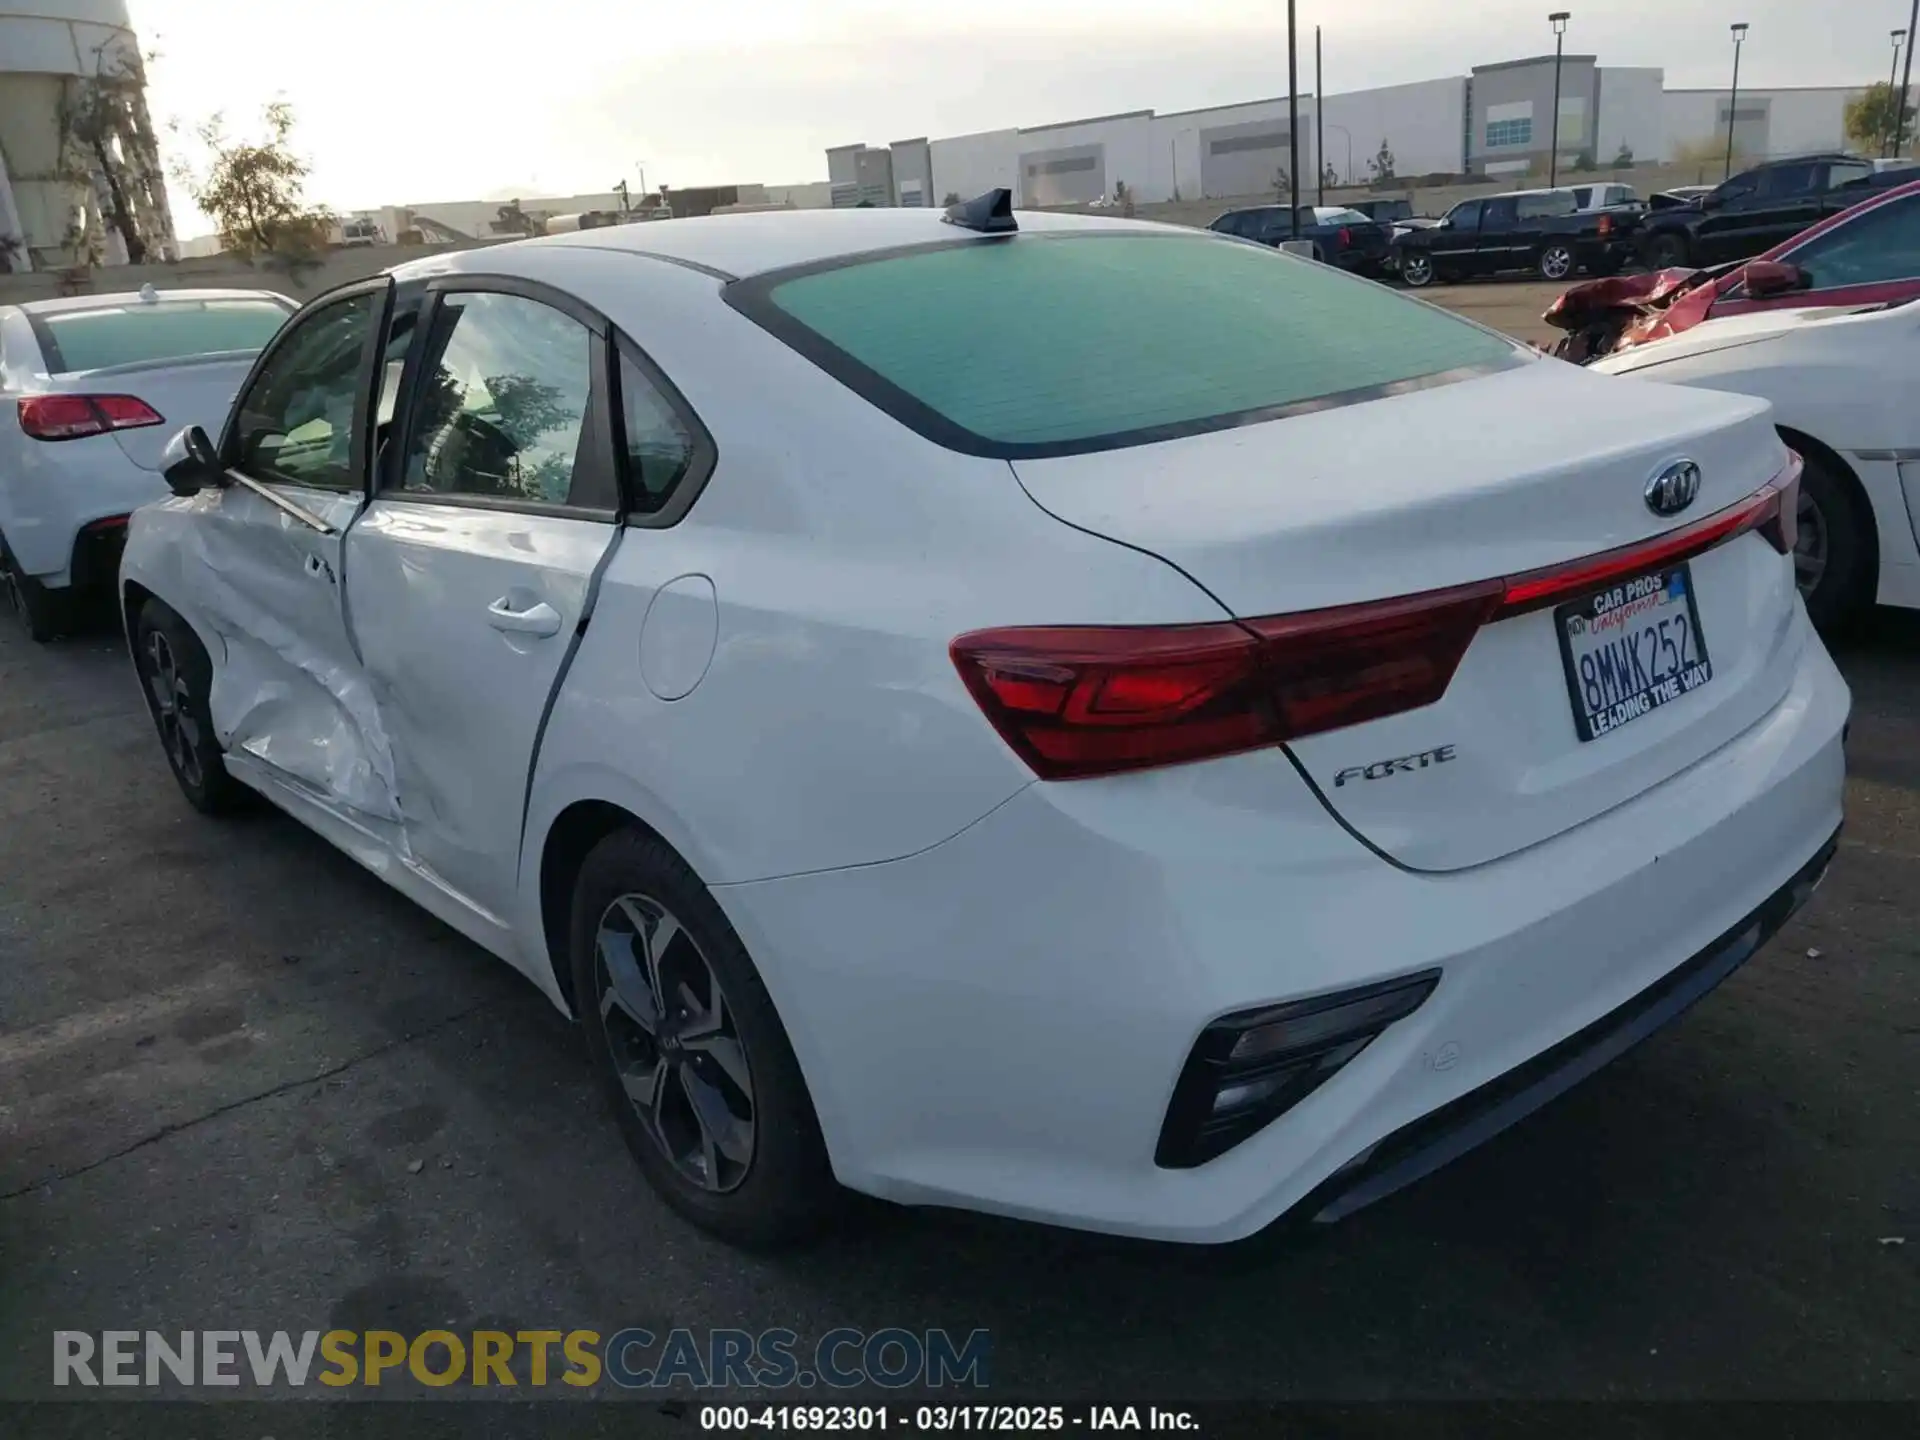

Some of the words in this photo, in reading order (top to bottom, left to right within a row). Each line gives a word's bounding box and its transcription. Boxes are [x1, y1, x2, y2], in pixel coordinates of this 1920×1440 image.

[1590, 593, 1660, 635] California
[1593, 588, 1624, 614] CAR
[1626, 573, 1663, 602] PROS
[1580, 614, 1695, 712] 8MWK252
[1589, 692, 1651, 738] LEADING
[1650, 676, 1681, 703] THE
[1681, 661, 1711, 690] WAY
[1333, 743, 1457, 788] FORTE
